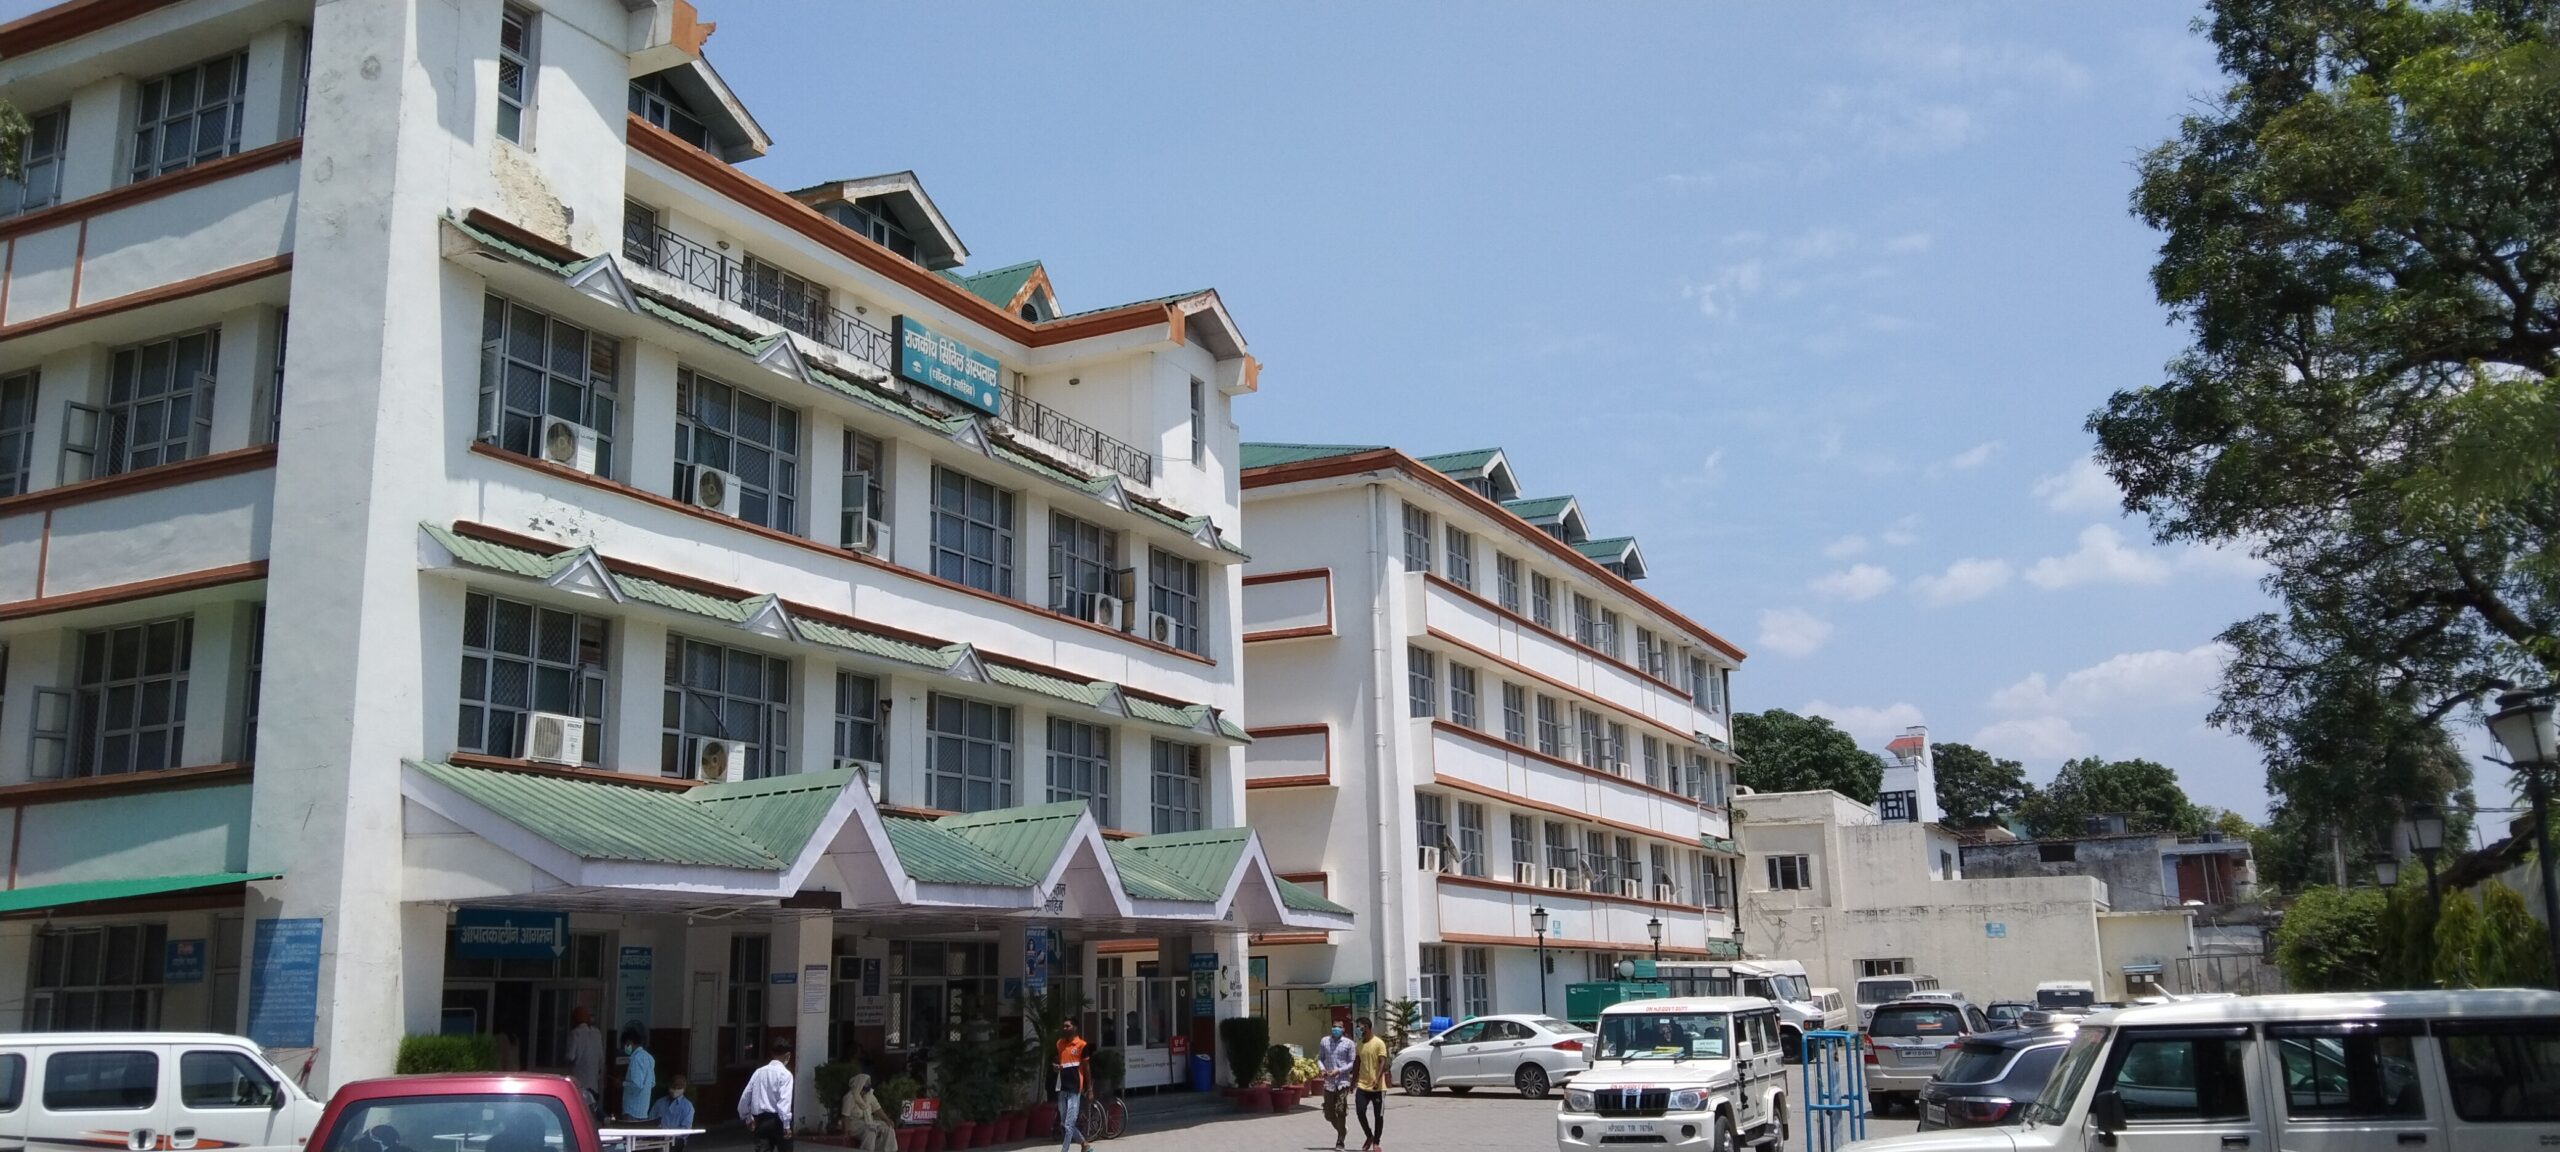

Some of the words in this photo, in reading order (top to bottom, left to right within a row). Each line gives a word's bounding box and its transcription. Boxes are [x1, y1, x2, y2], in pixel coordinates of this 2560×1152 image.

[904, 328, 938, 360] राजकीय
[939, 338, 964, 372] सिविल
[964, 356, 998, 388] अस्पताल
[460, 919, 518, 944] आपातकालीन
[520, 927, 553, 944] आगमन
[922, 1101, 931, 1110] NO
[914, 1110, 938, 1120] PARKING
